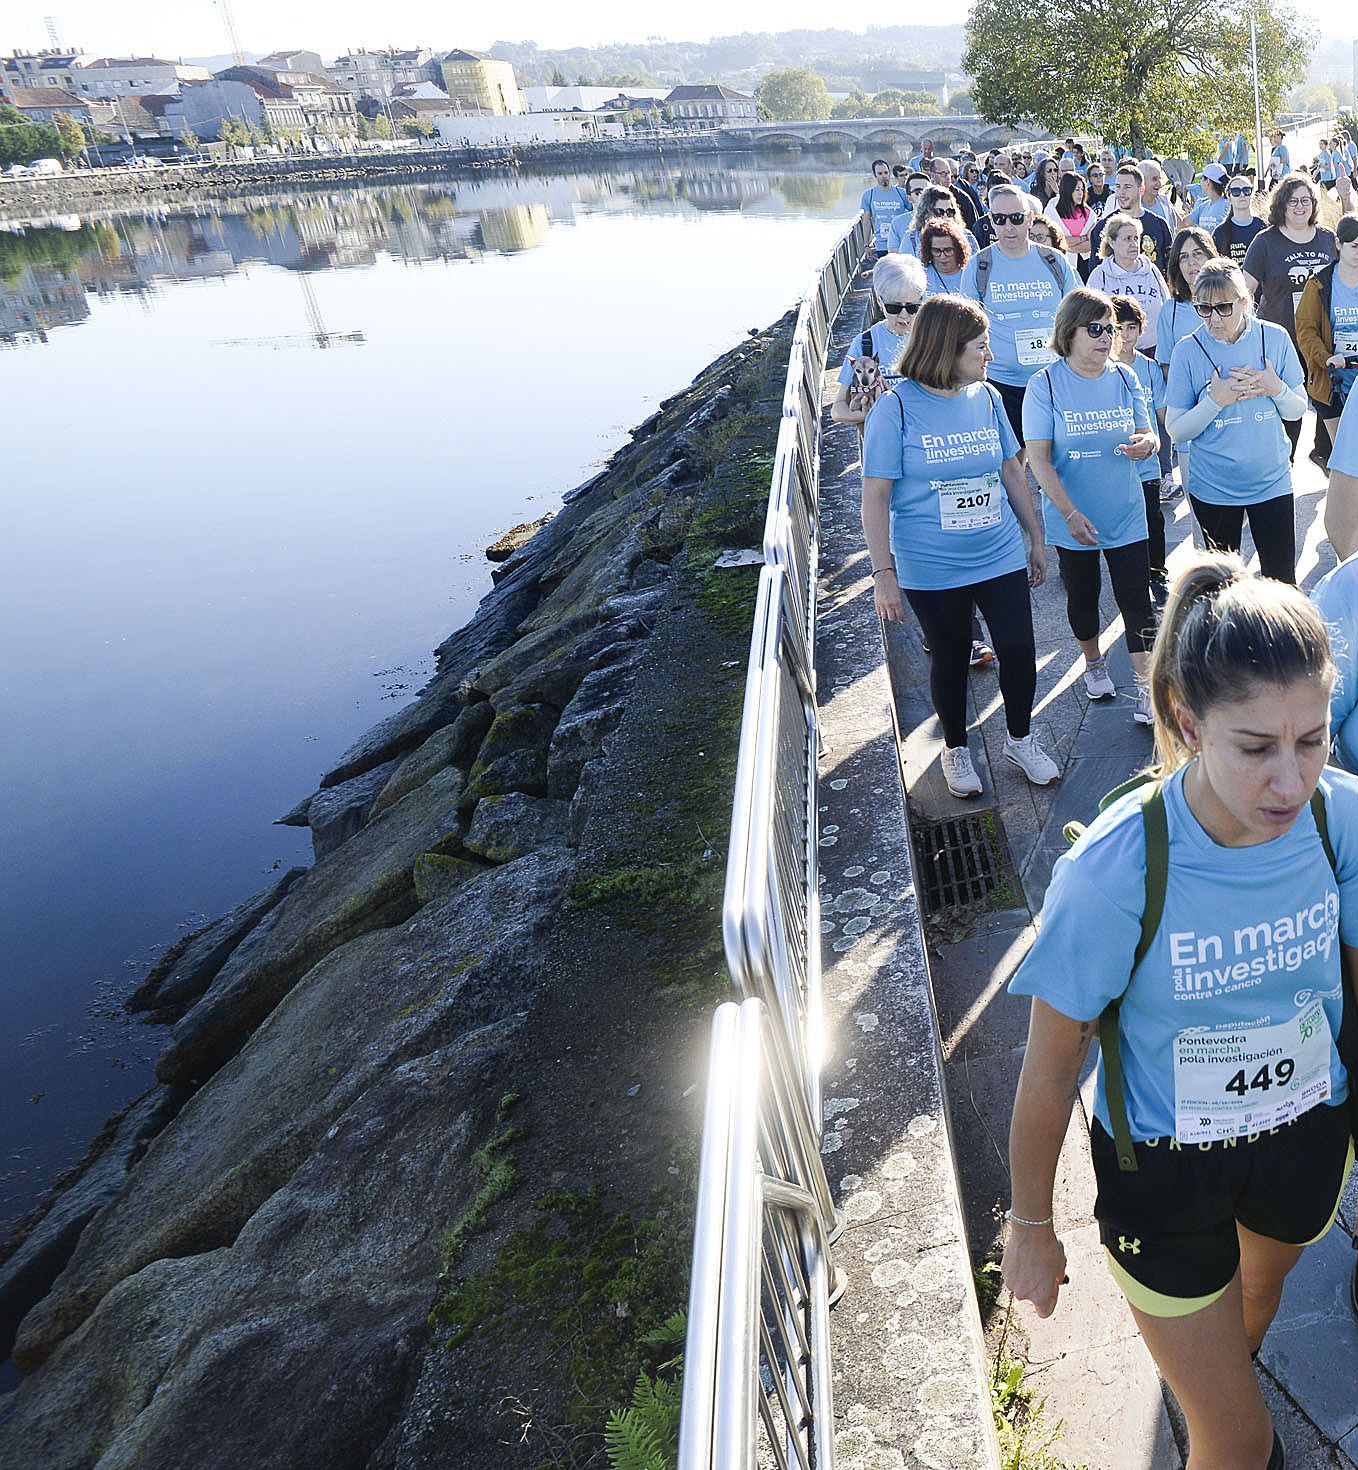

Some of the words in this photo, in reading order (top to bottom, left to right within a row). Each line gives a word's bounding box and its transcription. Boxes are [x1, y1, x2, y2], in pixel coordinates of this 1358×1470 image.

[1285, 252, 1304, 262] TALK
[990, 282, 1005, 292] En
[1007, 280, 1052, 291] marcha
[1334, 307, 1347, 316] En
[1063, 411, 1082, 422] En
[1085, 406, 1133, 420] marcha
[921, 434, 945, 448] En
[947, 426, 999, 445] marcha
[957, 493, 991, 509] 2107
[1169, 931, 1223, 966] En
[1234, 888, 1339, 955] march
[1173, 968, 1185, 992] pola
[1173, 990, 1213, 1001] contra
[1224, 977, 1262, 993] cancro
[1179, 1035, 1247, 1046] Pontevedra
[1179, 1055, 1205, 1065] pola
[1208, 1047, 1283, 1064] investigación
[1196, 1045, 1241, 1054] marcha
[1225, 1058, 1295, 1097] 449
